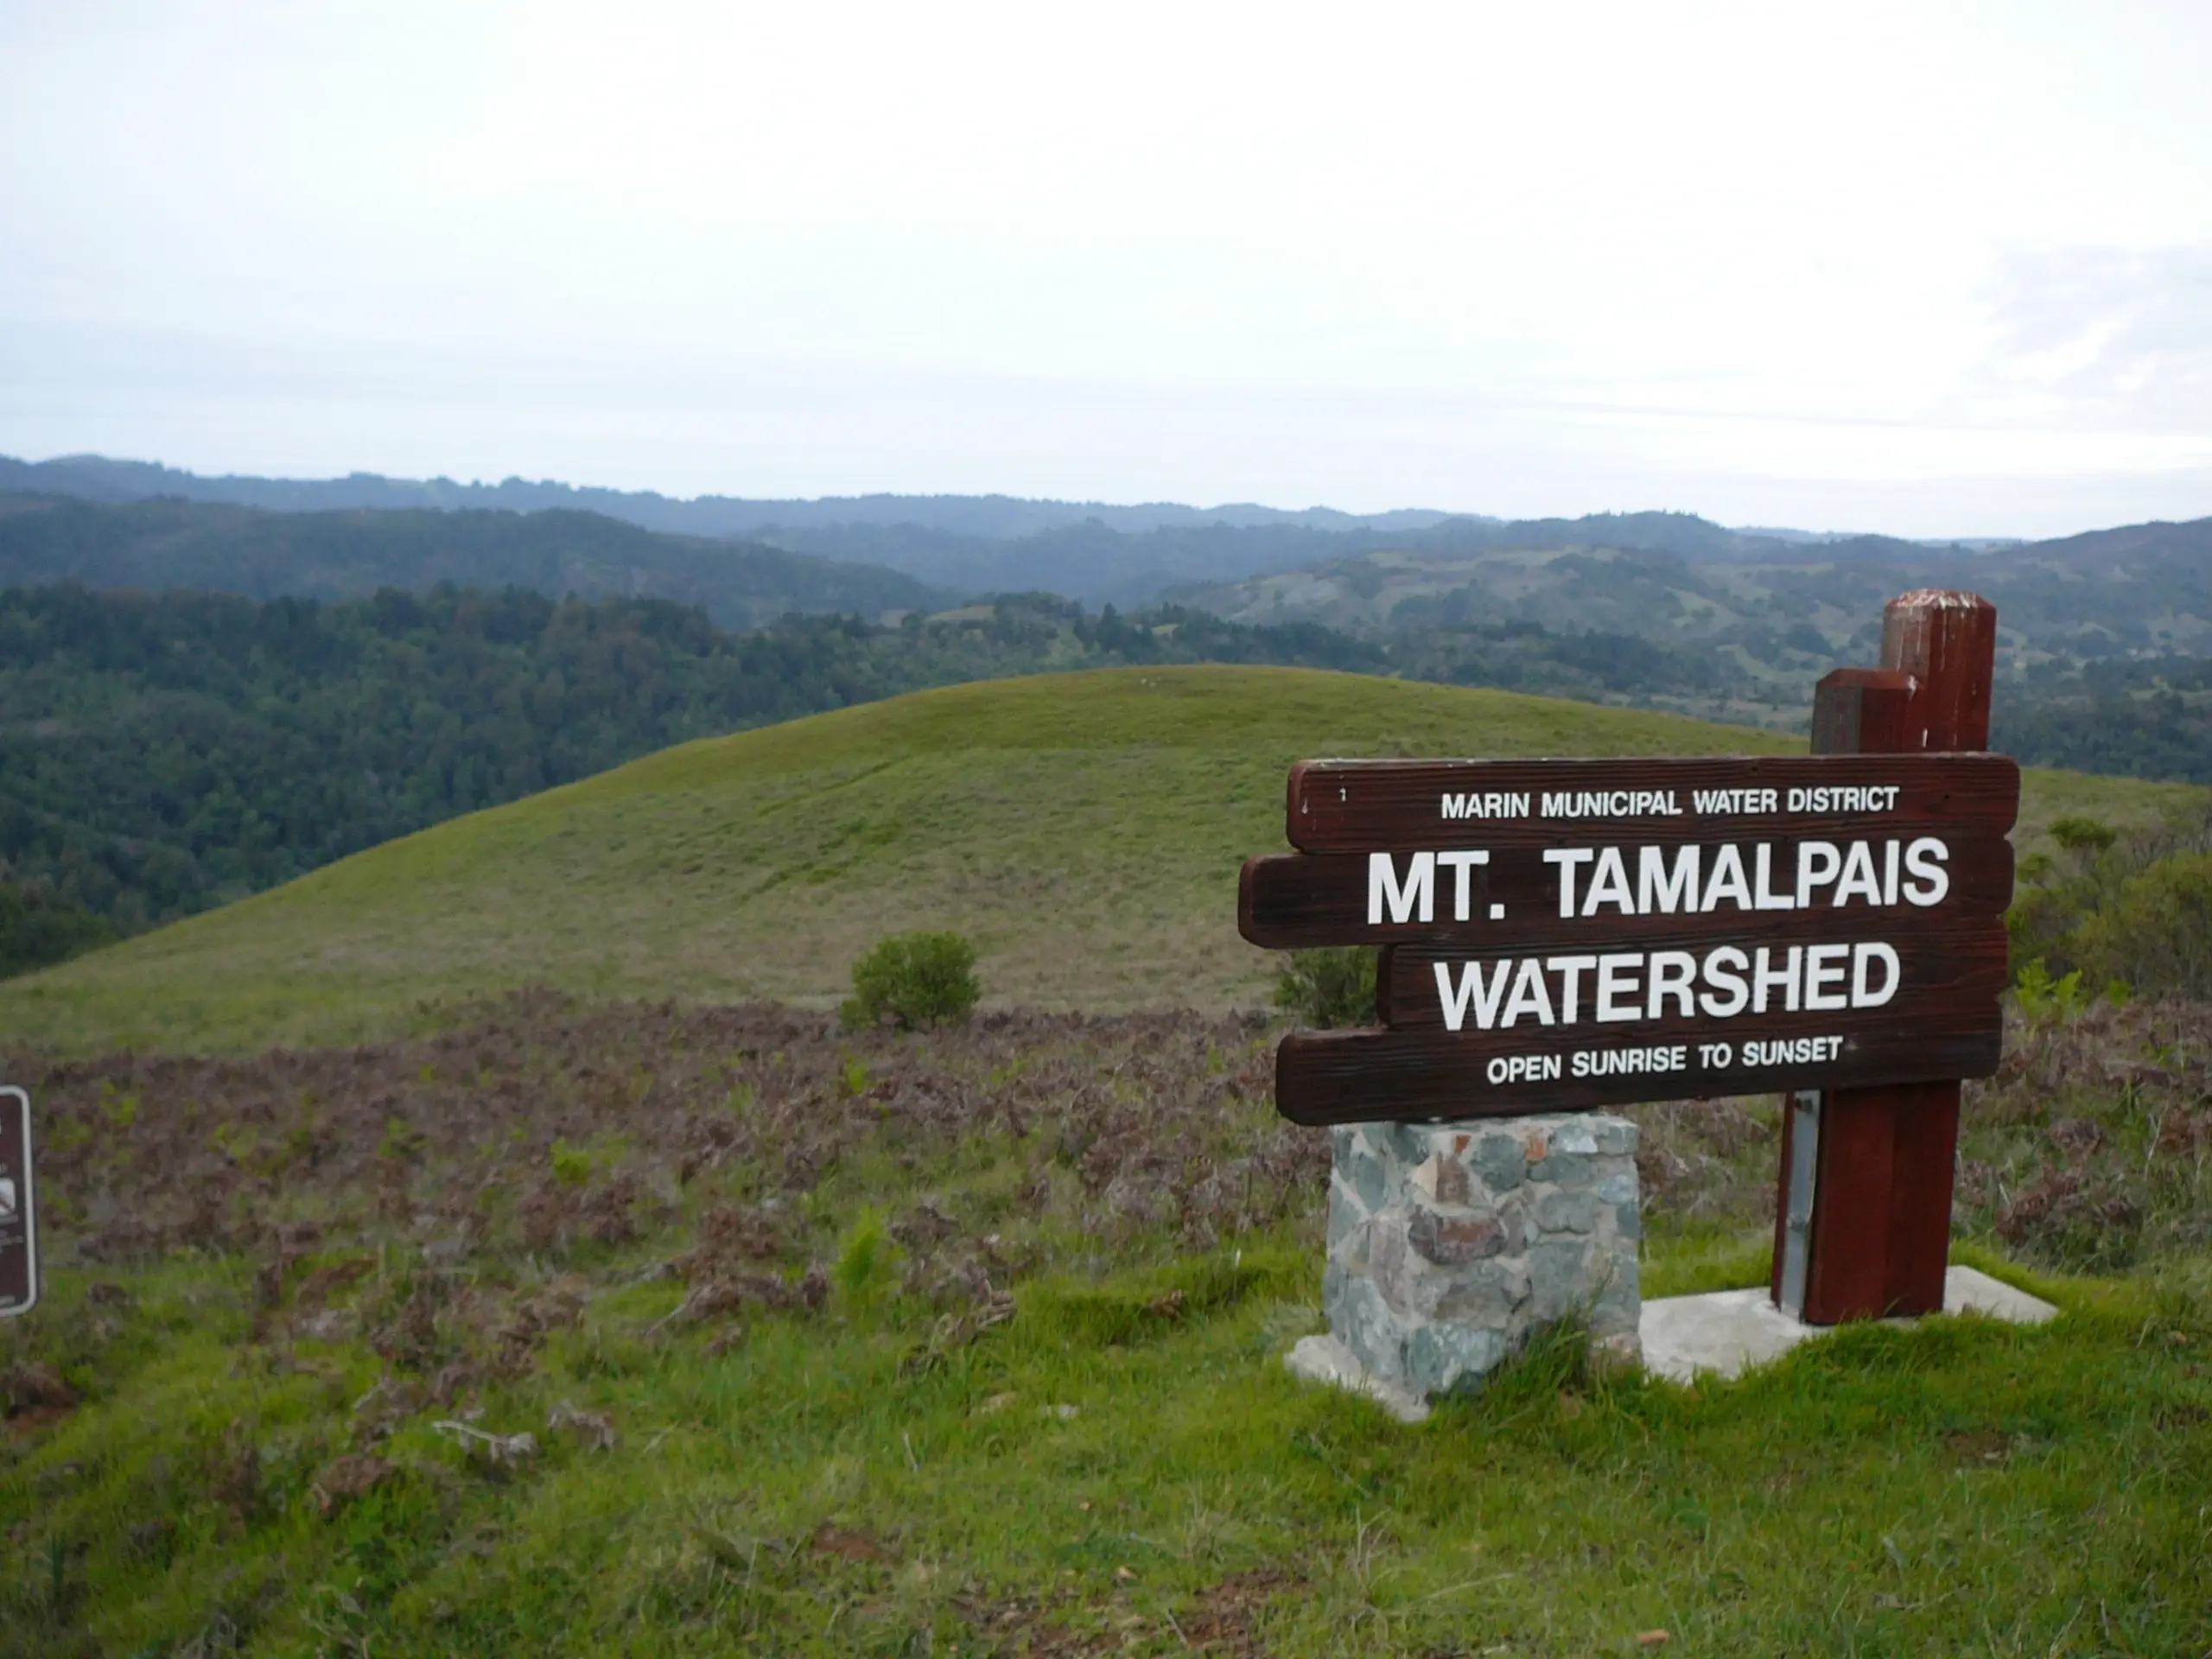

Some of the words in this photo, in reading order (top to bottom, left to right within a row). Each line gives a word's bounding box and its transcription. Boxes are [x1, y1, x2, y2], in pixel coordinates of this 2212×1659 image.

[1441, 793, 1529, 818] MARIN
[1541, 791, 1682, 817] MUNICIPAL
[1693, 789, 1777, 814] WATER
[1788, 786, 1899, 812] DISTRICT
[1368, 850, 1504, 924] MT.
[1543, 837, 1948, 918] TAMALPAIS
[1433, 942, 1900, 1030] WATERSHED
[1487, 1054, 1561, 1084] OPEN
[1572, 1046, 1687, 1077] SUNRISE
[1699, 1043, 1732, 1068] TO
[1742, 1036, 1843, 1066] SUNSET
